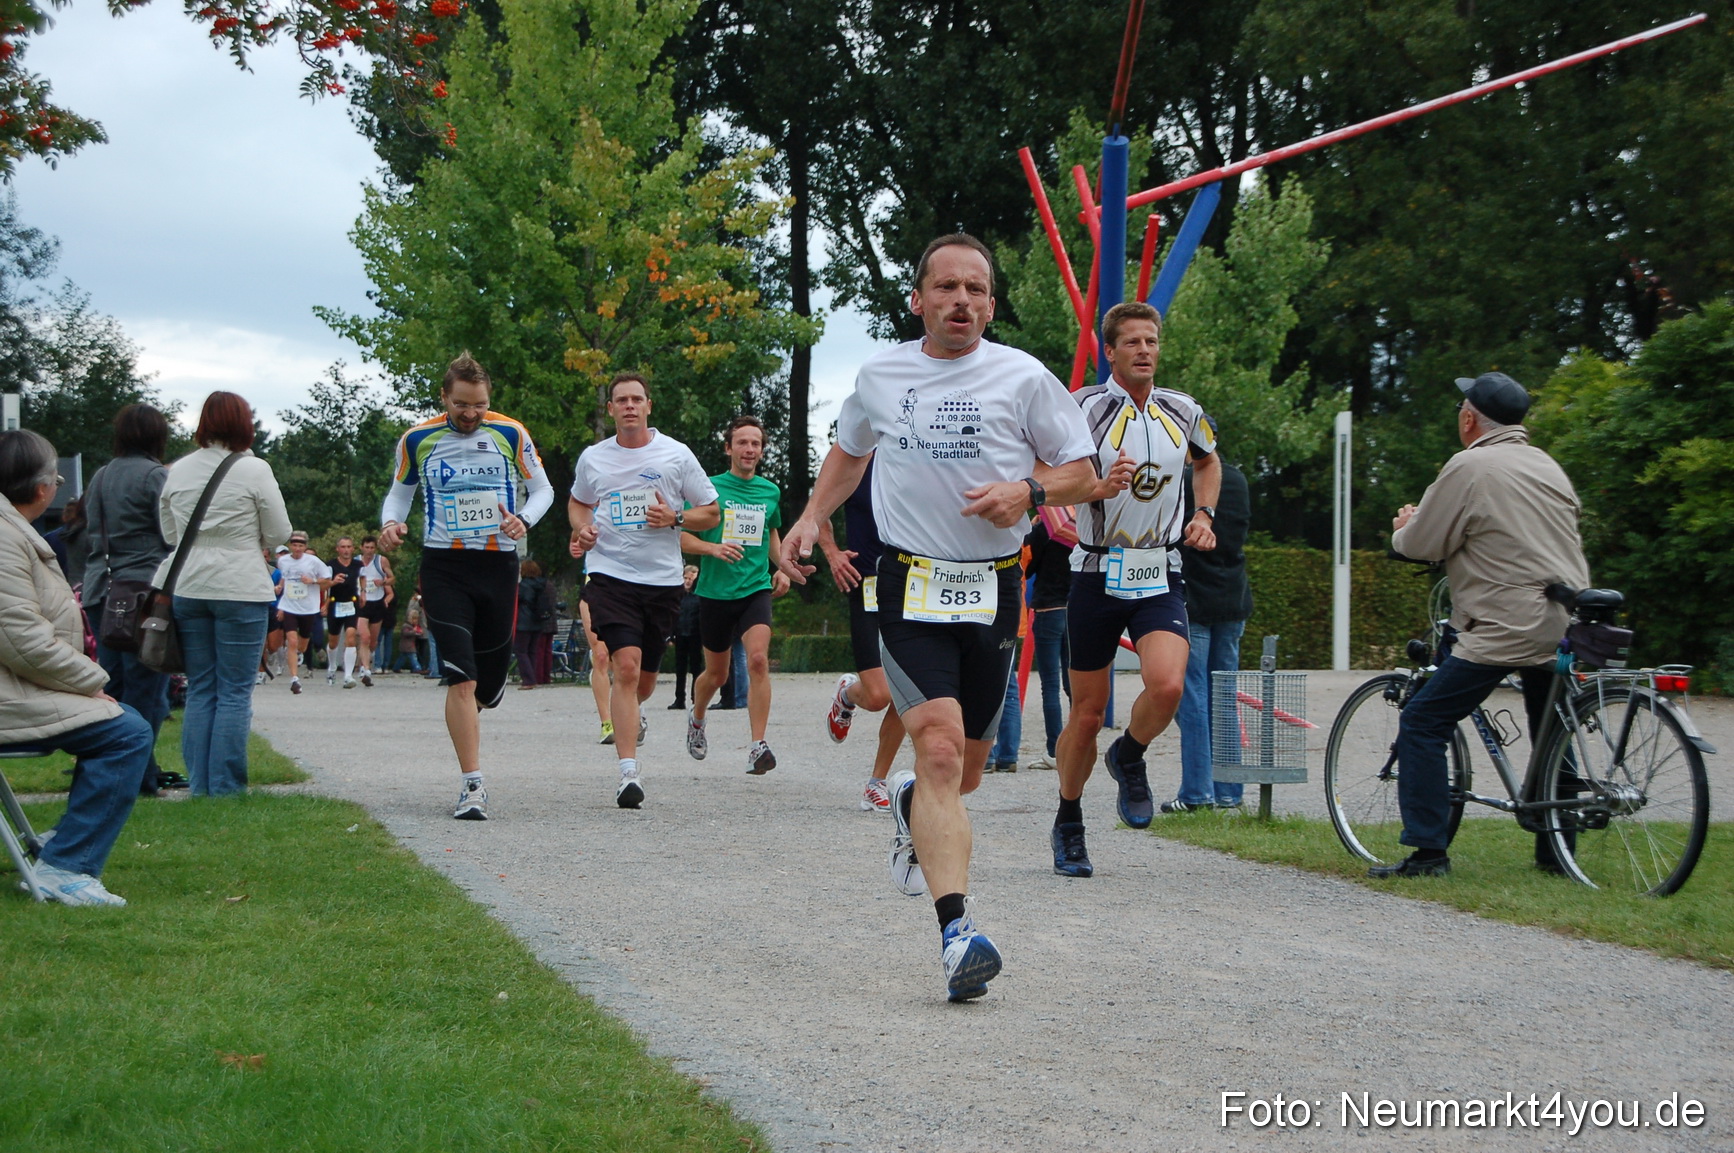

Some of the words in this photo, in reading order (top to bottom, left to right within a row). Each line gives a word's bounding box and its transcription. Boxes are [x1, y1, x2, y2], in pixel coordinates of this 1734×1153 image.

[935, 414, 981, 422] 21.09.2008
[899, 437, 914, 450] 9.
[917, 440, 980, 450] Neumarkter
[932, 449, 981, 459] Stadtlauf
[461, 467, 501, 475] PLAST
[458, 498, 480, 506] Martin
[623, 494, 646, 502] Michael
[461, 508, 493, 522] 3213
[625, 505, 650, 517] 221
[735, 513, 756, 521] Michael
[738, 524, 757, 535] 389
[933, 567, 985, 583] Friedrich
[1126, 566, 1160, 581] 3000
[910, 582, 916, 591] A
[940, 588, 982, 606] 583
